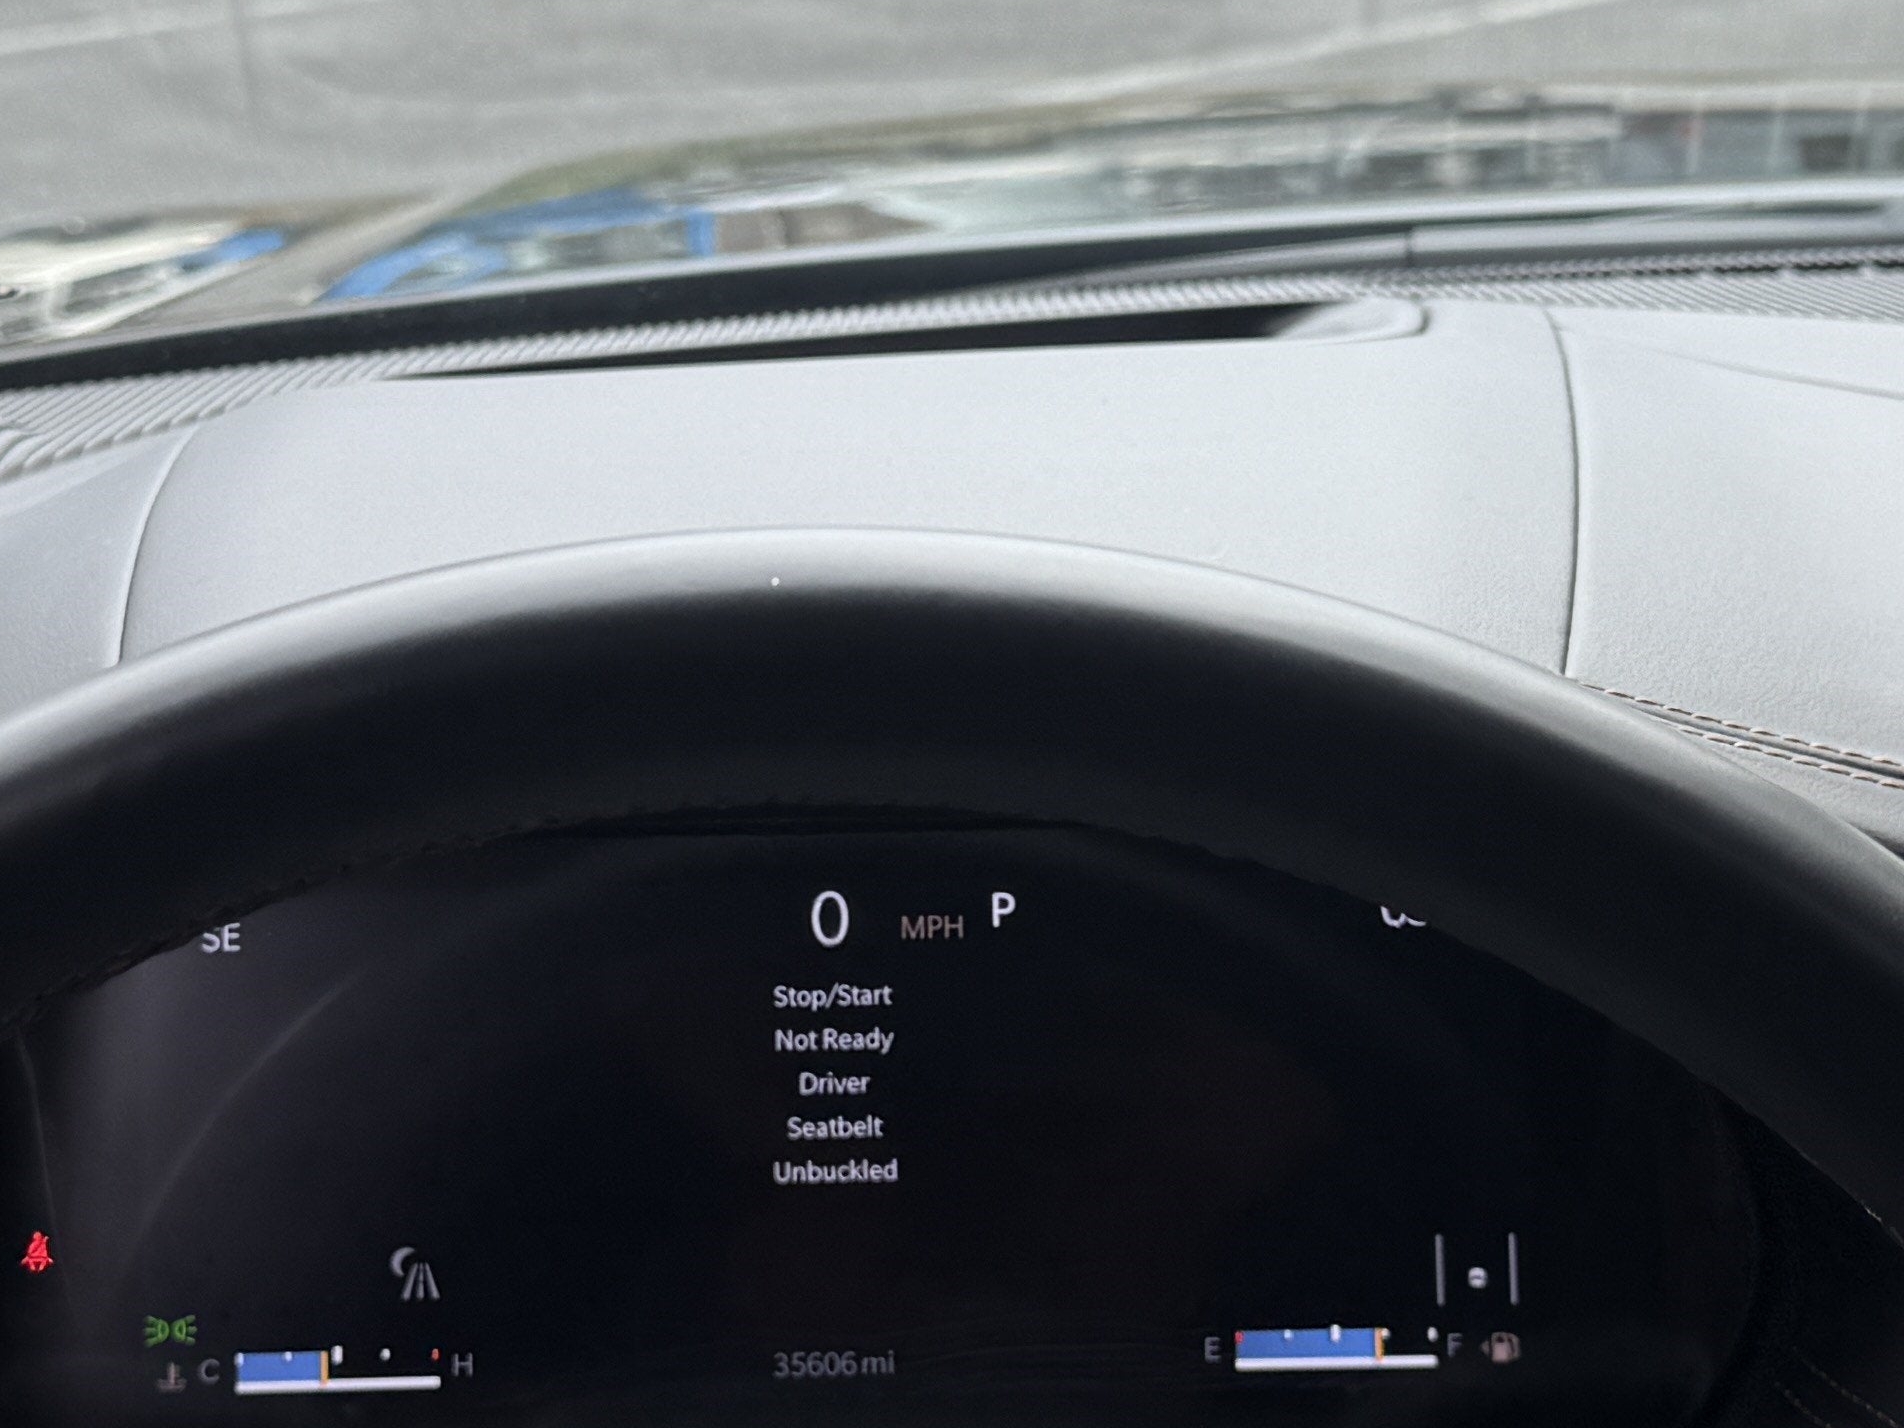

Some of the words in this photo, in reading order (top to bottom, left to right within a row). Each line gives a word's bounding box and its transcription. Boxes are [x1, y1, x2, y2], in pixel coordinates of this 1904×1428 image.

[811, 890, 849, 947] 0
[901, 915, 964, 939] MPH
[991, 891, 1016, 928] P
[201, 922, 242, 953] SE
[773, 982, 893, 1012] Stop/Start
[774, 1028, 818, 1052] Not
[822, 1026, 895, 1055] Ready
[798, 1071, 871, 1096] Driver
[786, 1114, 884, 1140] Seatbelt
[772, 1158, 898, 1184] Unbuckled
[1204, 1336, 1223, 1363] E
[1447, 1332, 1463, 1358] F
[200, 1358, 221, 1385] C
[451, 1352, 474, 1377] H
[773, 1351, 858, 1378] 35606
[860, 1349, 895, 1375] mi
